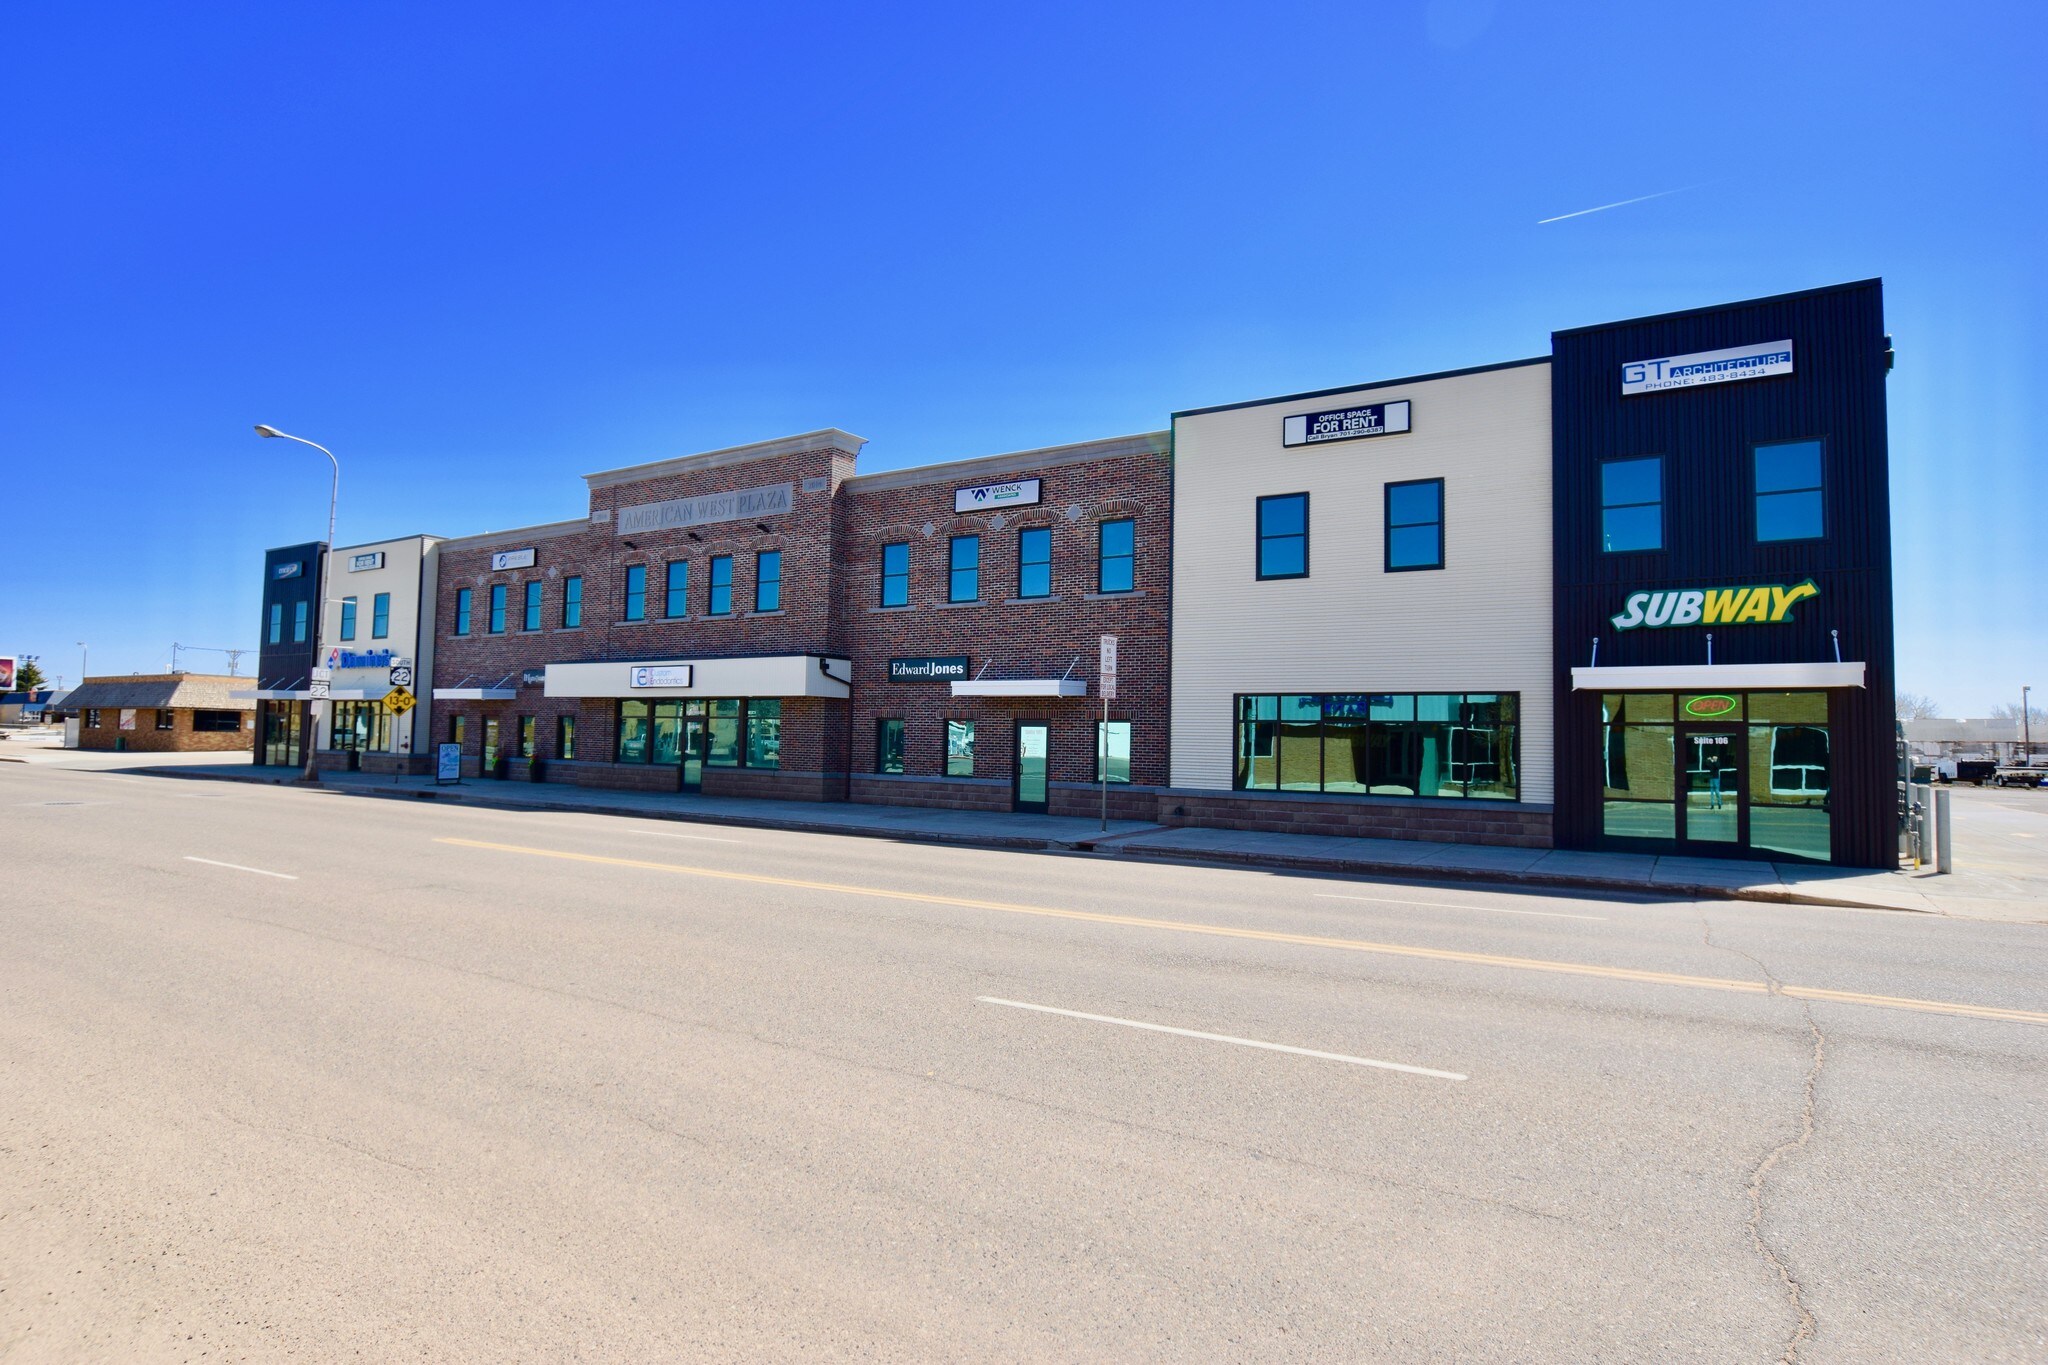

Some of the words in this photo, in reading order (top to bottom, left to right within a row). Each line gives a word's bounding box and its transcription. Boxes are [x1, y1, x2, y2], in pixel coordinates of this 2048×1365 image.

[1622, 359, 1670, 385] GT
[1673, 353, 1788, 378] ARCHITECTURE
[1645, 378, 1695, 391] PHONE:
[1699, 368, 1766, 383] 483-8434
[1318, 413, 1345, 423] OFFICE
[1346, 408, 1372, 419] SPACE
[1313, 420, 1339, 434] FOR
[1342, 415, 1378, 431] RENT
[1320, 433, 1338, 441] Bryan
[991, 483, 1022, 494] WENCK
[624, 503, 694, 530] AMERICAN
[697, 497, 736, 521] WEST
[737, 489, 788, 514] PLAZA
[1612, 582, 1817, 630] SUBWAY
[892, 662, 930, 676] Edward
[930, 662, 964, 676] Jones
[393, 671, 409, 682] 22
[310, 686, 327, 697] 22
[1692, 699, 1731, 712] OPEN
[1715, 736, 1729, 745] 106
